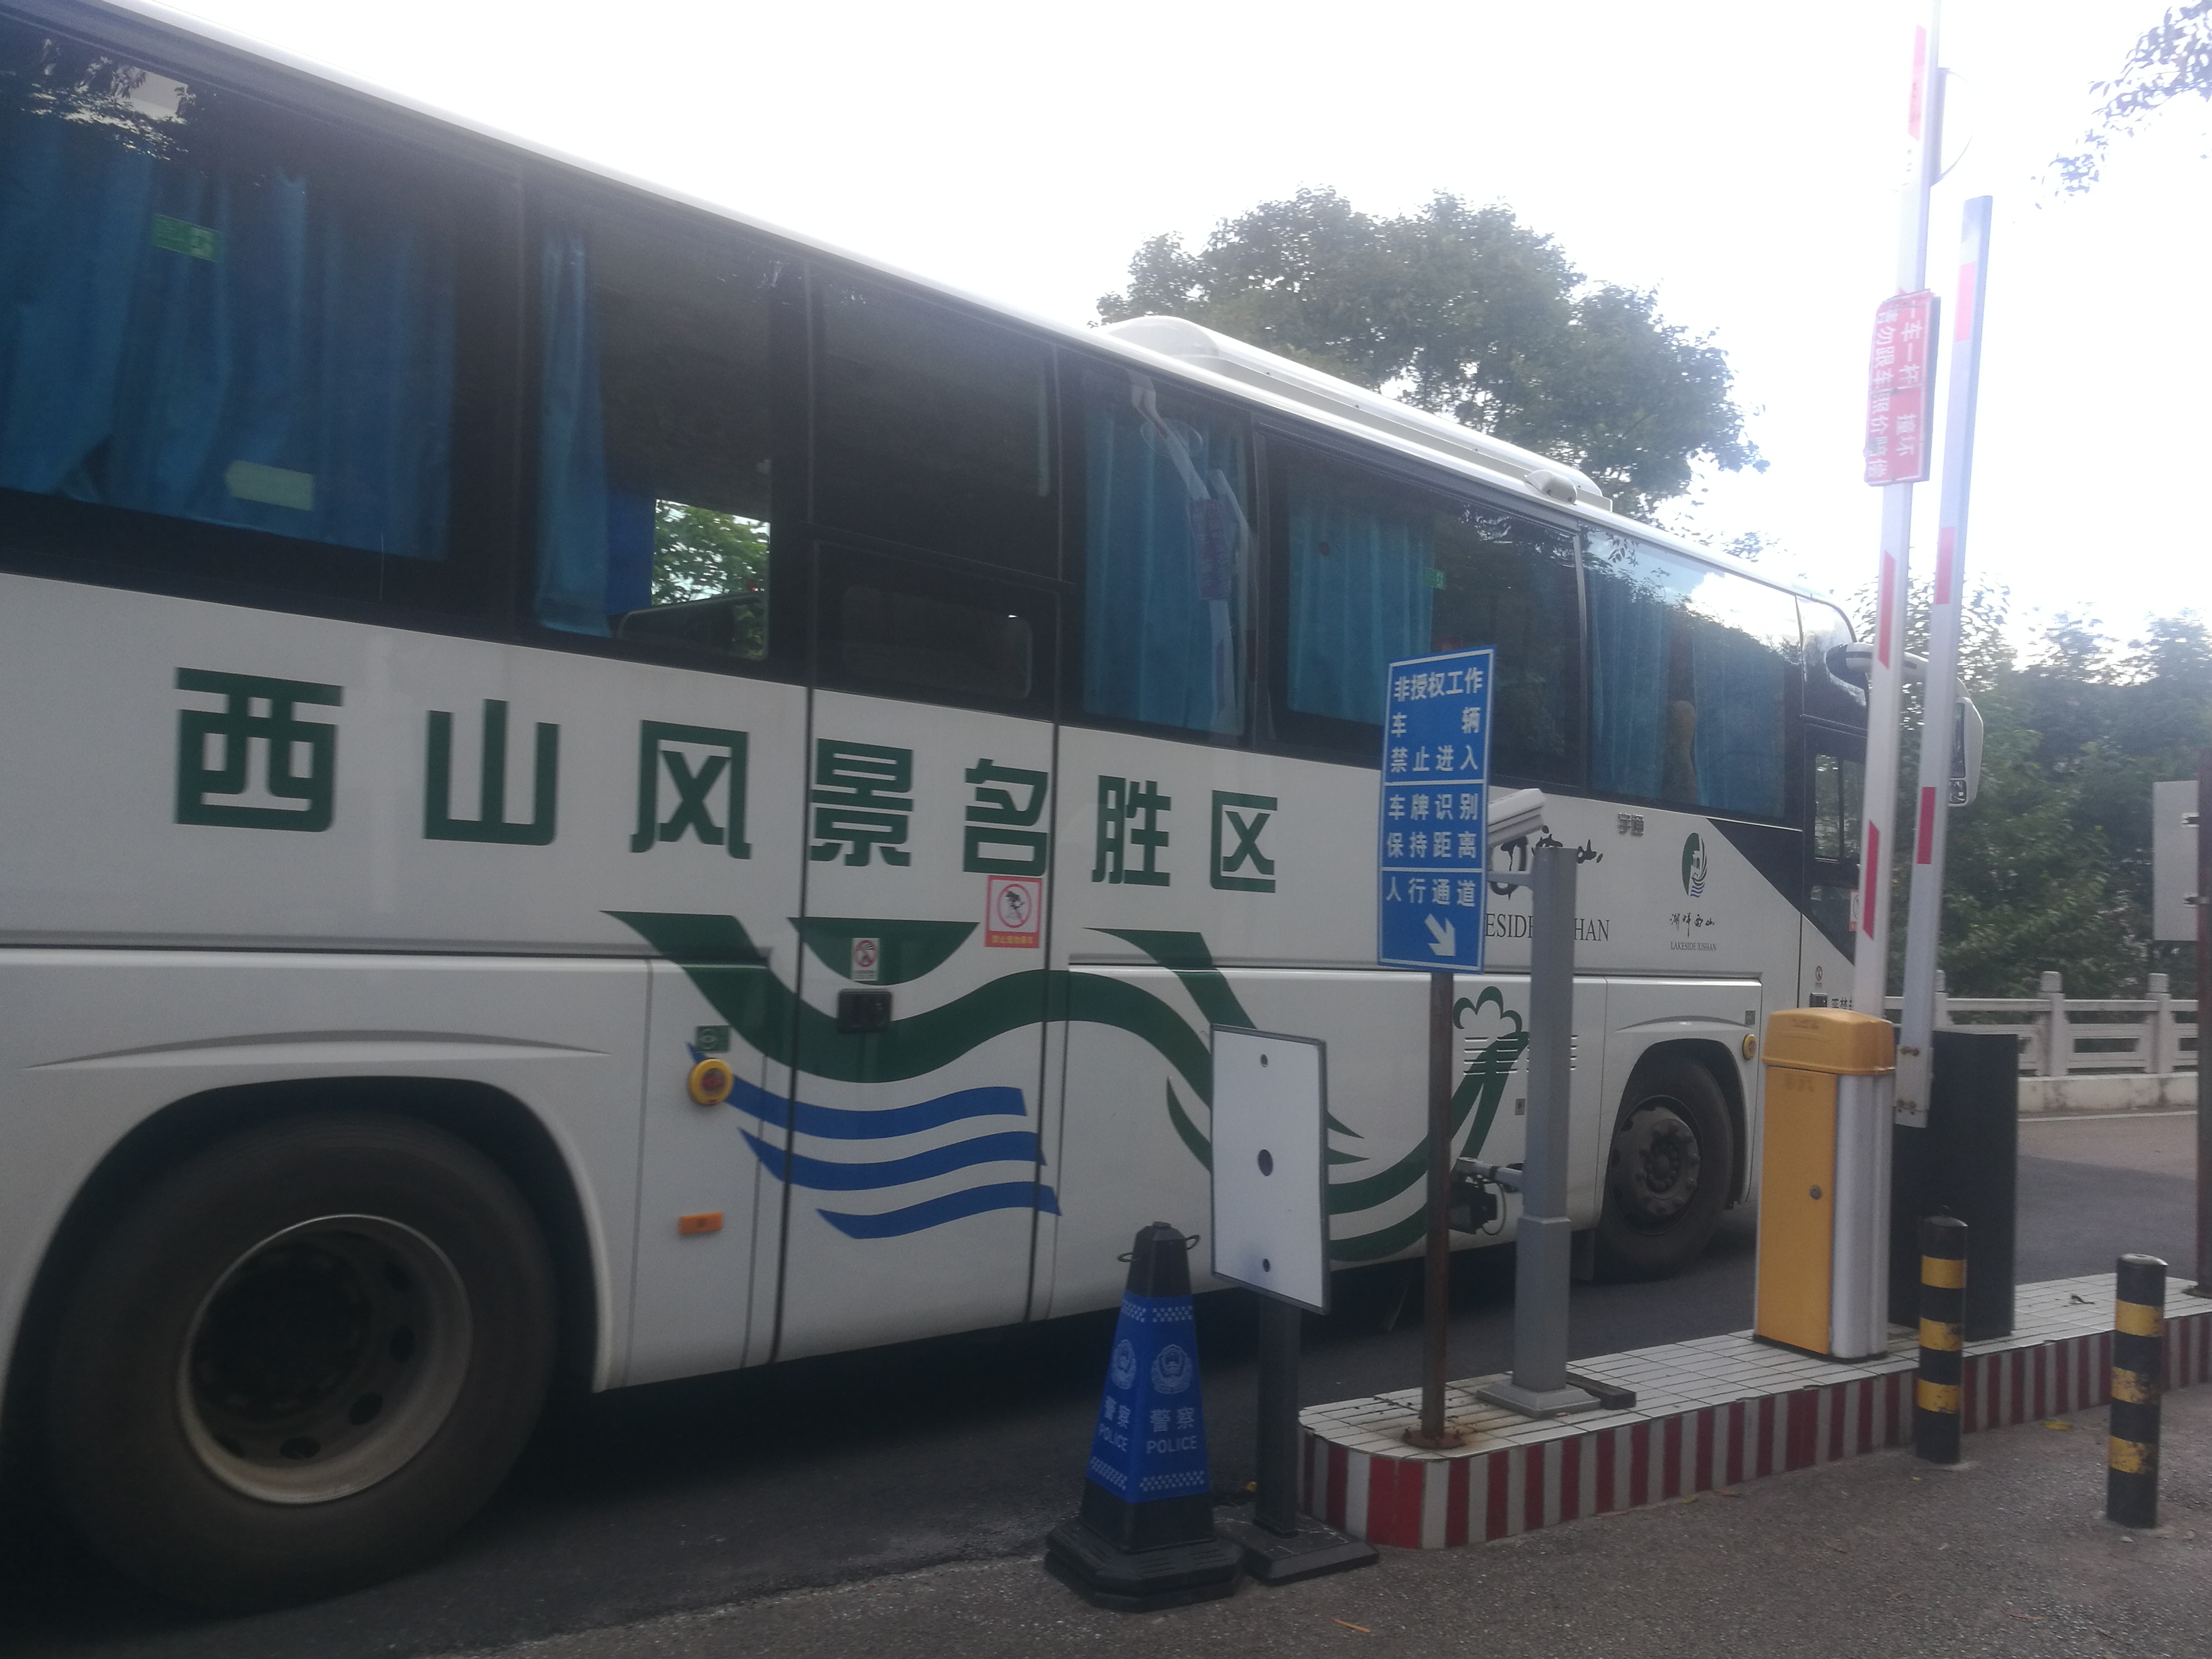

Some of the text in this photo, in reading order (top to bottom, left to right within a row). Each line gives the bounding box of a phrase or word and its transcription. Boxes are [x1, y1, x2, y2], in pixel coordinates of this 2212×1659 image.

[1899, 300, 1923, 385] 一车一杆
[1394, 667, 1483, 702] 非授权工作
[1390, 744, 1479, 773] 禁止进入
[174, 667, 1277, 894] 西山风景名胜区
[1388, 793, 1477, 822] 车牌识别
[1386, 831, 1477, 859] 保持距离
[1385, 876, 1476, 908] 人行通道
[1671, 942, 1716, 951] LAKESIDE XISHAN
[1104, 1395, 1131, 1429] 警察
[1149, 1406, 1195, 1433] 警察
[1098, 1423, 1129, 1452] POLICE
[1146, 1435, 1198, 1454] POLICE
